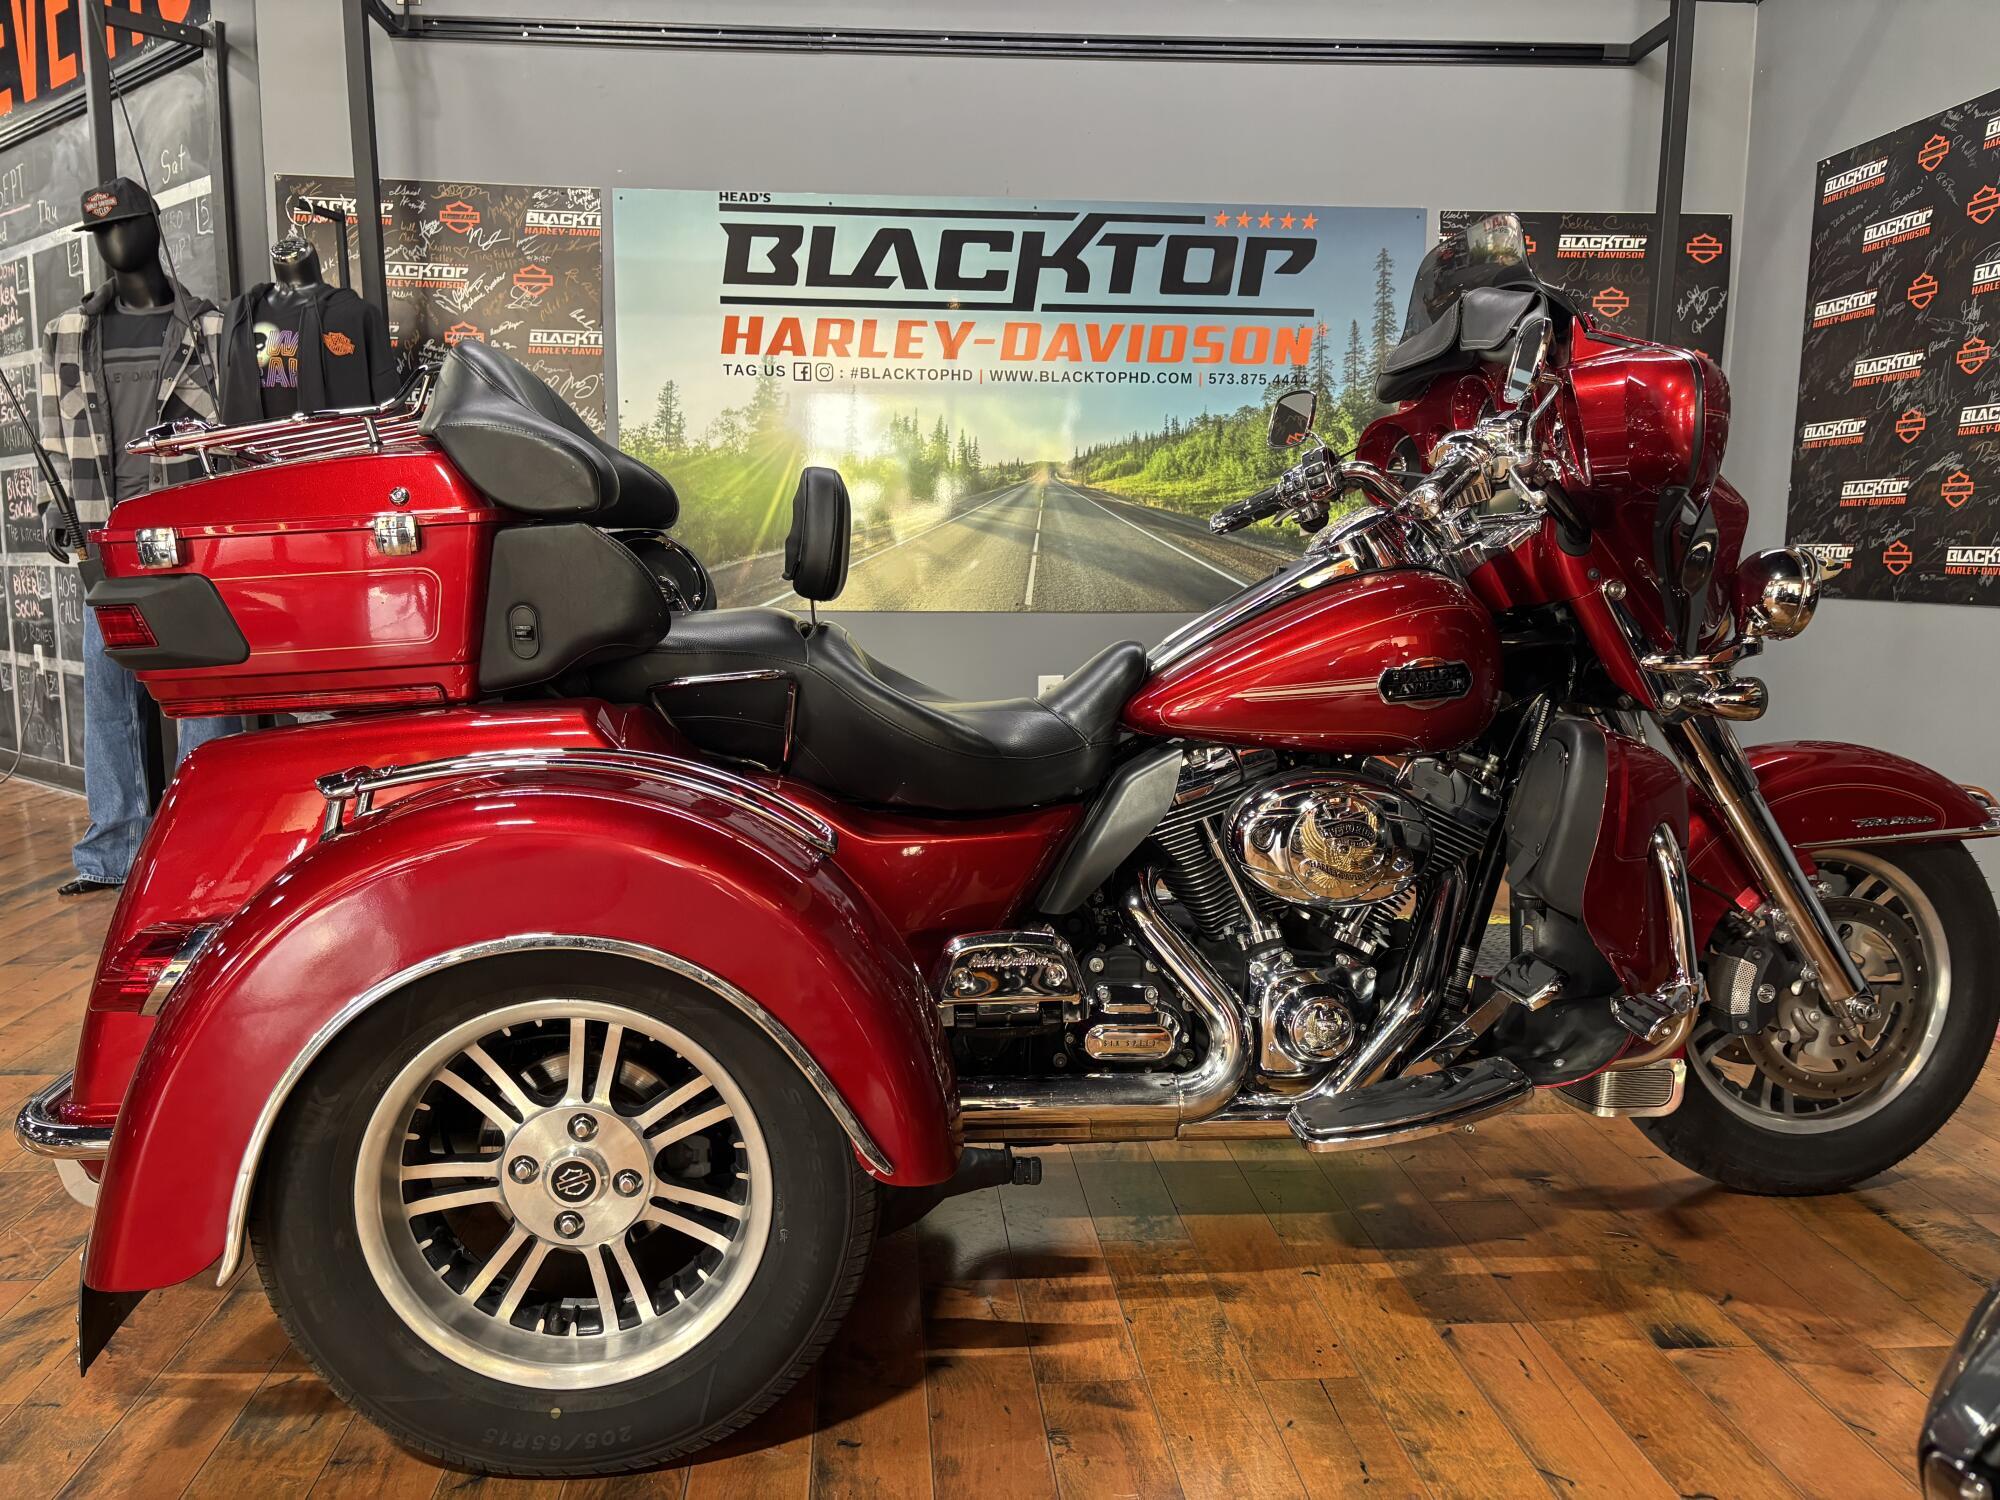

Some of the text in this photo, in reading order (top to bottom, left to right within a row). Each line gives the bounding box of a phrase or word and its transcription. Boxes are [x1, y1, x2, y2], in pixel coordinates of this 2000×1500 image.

[161, 144, 186, 184] Sat
[1824, 158, 1888, 194] BLACKTOP
[719, 191, 771, 203] HEAD'S
[1822, 175, 1886, 206] HARLEY-DAVIDSON
[37, 199, 58, 223] Thu
[526, 211, 601, 228] BLACKT
[524, 227, 600, 237] HARLEY-DAVID
[1863, 208, 1934, 243] BLACKTOP
[1558, 234, 1648, 251] BLACKTOP
[1862, 226, 1931, 254] HARLEY-DAVIDSON
[71, 241, 80, 268] 3
[719, 213, 1318, 311] BLACKTOP
[1557, 251, 1645, 260] HARLEY-DAVIDSON
[385, 264, 469, 279] LACKTOP
[386, 279, 467, 289] RLEY-DAVIDSON
[1814, 290, 1878, 318] BLACKTOP
[1812, 307, 1876, 329] HARLEY-DAVIDSON
[529, 332, 603, 346] BLACKT
[720, 315, 1313, 365] HARLEY-DAVIDSON
[528, 346, 602, 356] HARLEY-DAVID
[723, 363, 757, 377] TAG
[763, 364, 786, 378] US
[850, 367, 973, 382] #BLACKTOPHD
[989, 368, 1193, 385] WWW.BLACKTOPHD.COM
[1208, 372, 1308, 386] 573.875.4444
[1854, 352, 1925, 377] BLACKTOP
[1852, 369, 1921, 388] HARLEY-DAVIDSON
[1960, 406, 2000, 424] BLAC
[1803, 419, 1867, 439] BLACKTOP
[7, 476, 34, 501] BIKER
[1841, 480, 1910, 497] BLACKTOP
[9, 500, 38, 521] SOCIAL
[1840, 496, 1907, 507] HARLEY-DAVIDSON
[1946, 547, 2000, 566] BLACK
[13, 574, 41, 600] BIKER
[57, 571, 77, 598] HOG
[15, 600, 44, 619] SOCIAL
[59, 600, 80, 625] CALL
[1103, 1039, 1120, 1047] SIX
[482, 1425, 633, 1451] 205/65R15
